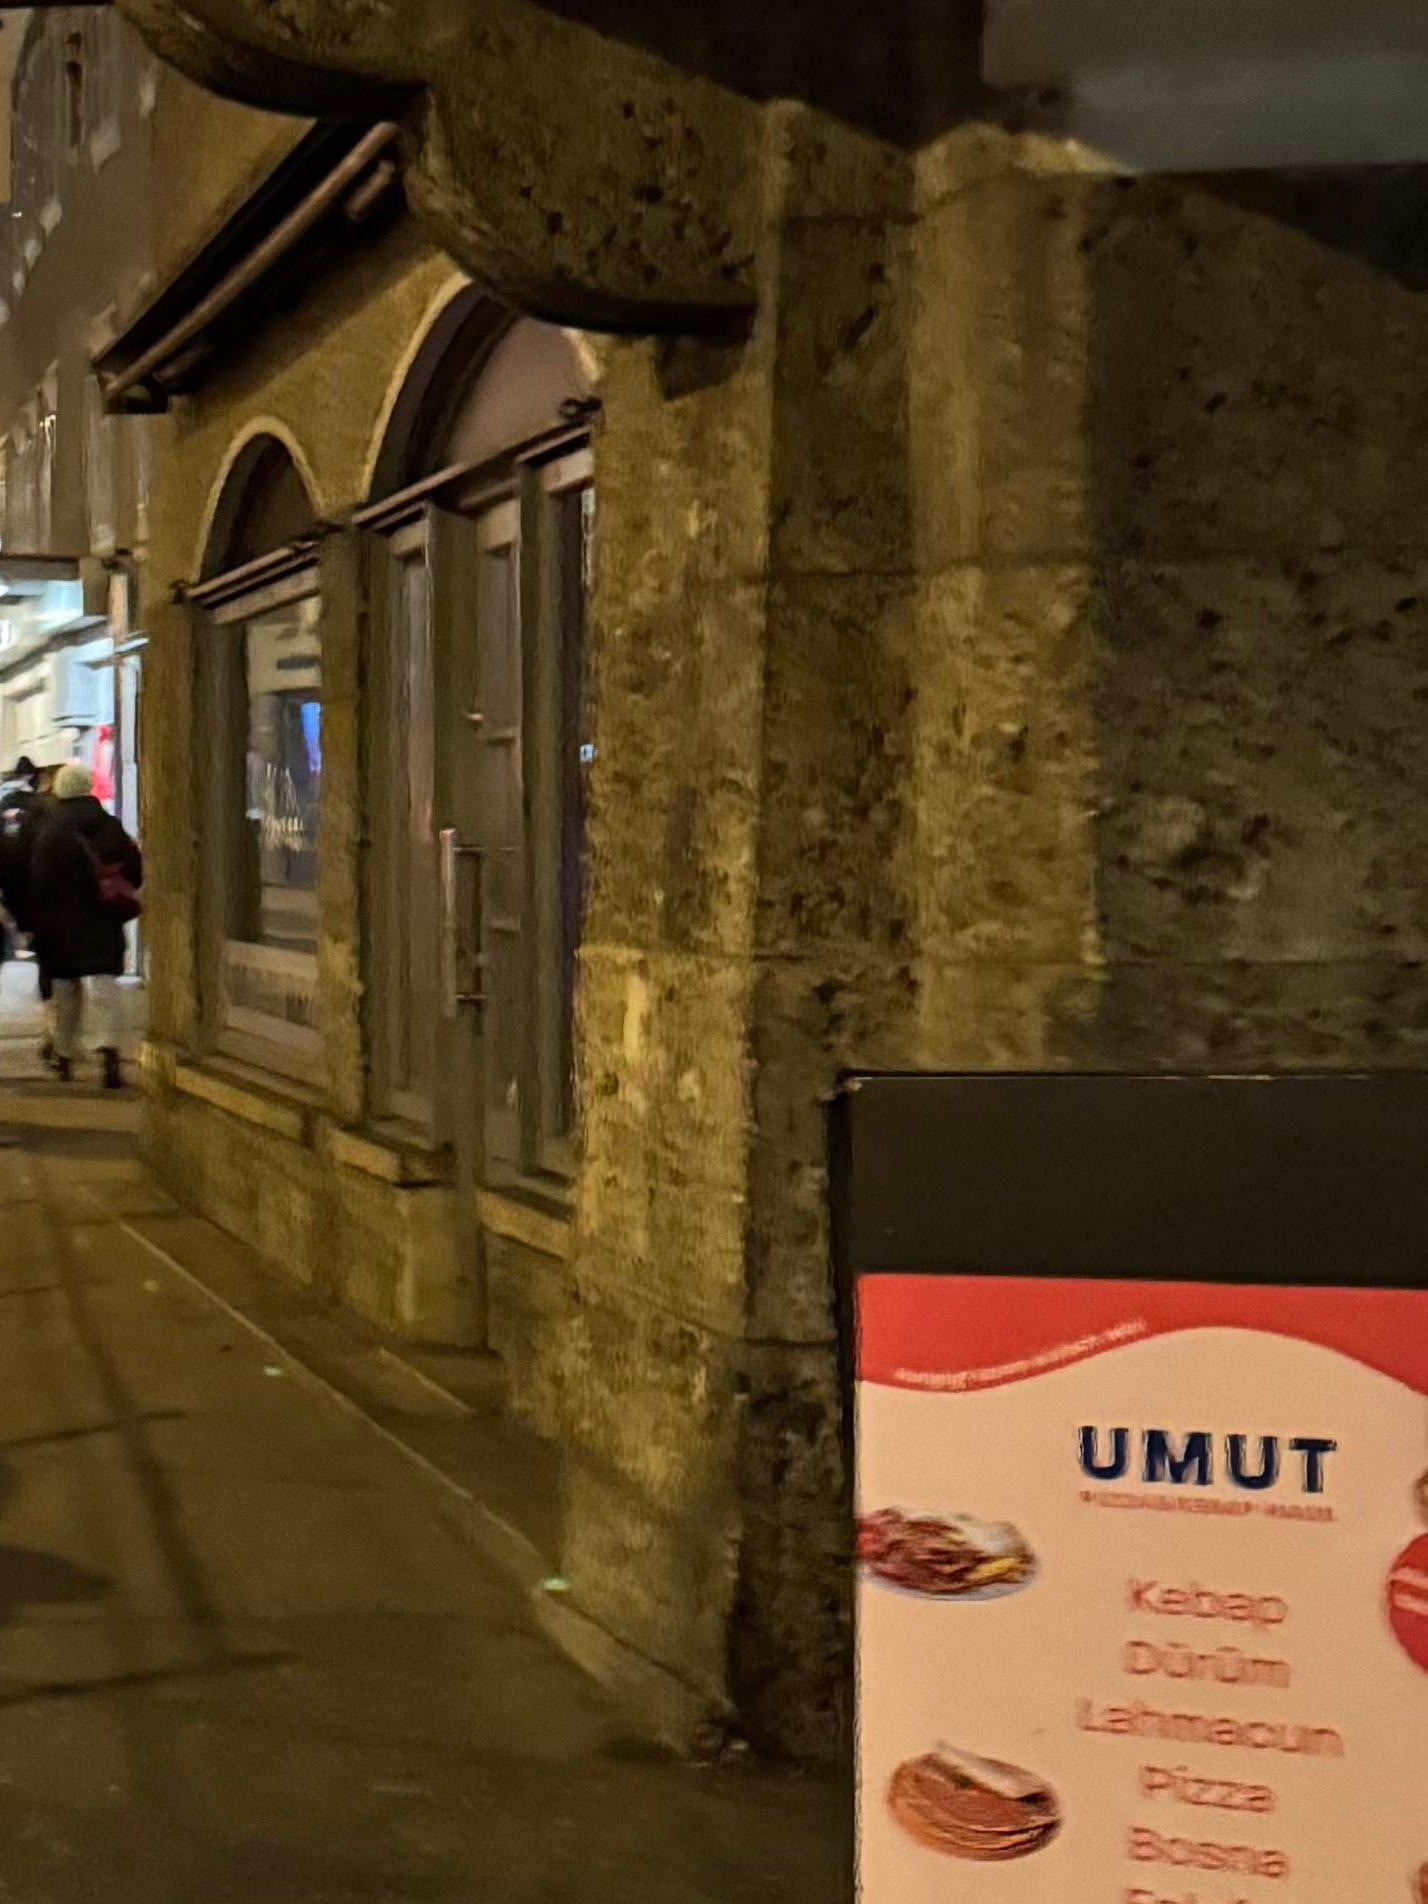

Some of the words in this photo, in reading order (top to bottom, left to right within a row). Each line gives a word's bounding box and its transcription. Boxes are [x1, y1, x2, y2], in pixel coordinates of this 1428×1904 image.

[1077, 1425, 1337, 1493] UMUT
[1125, 1578, 1288, 1633] Kebap
[1121, 1640, 1291, 1688] Dürüm
[1076, 1698, 1345, 1757] Lahmacun
[1140, 1764, 1275, 1812] Pizza
[1128, 1827, 1288, 1878] Bosna
